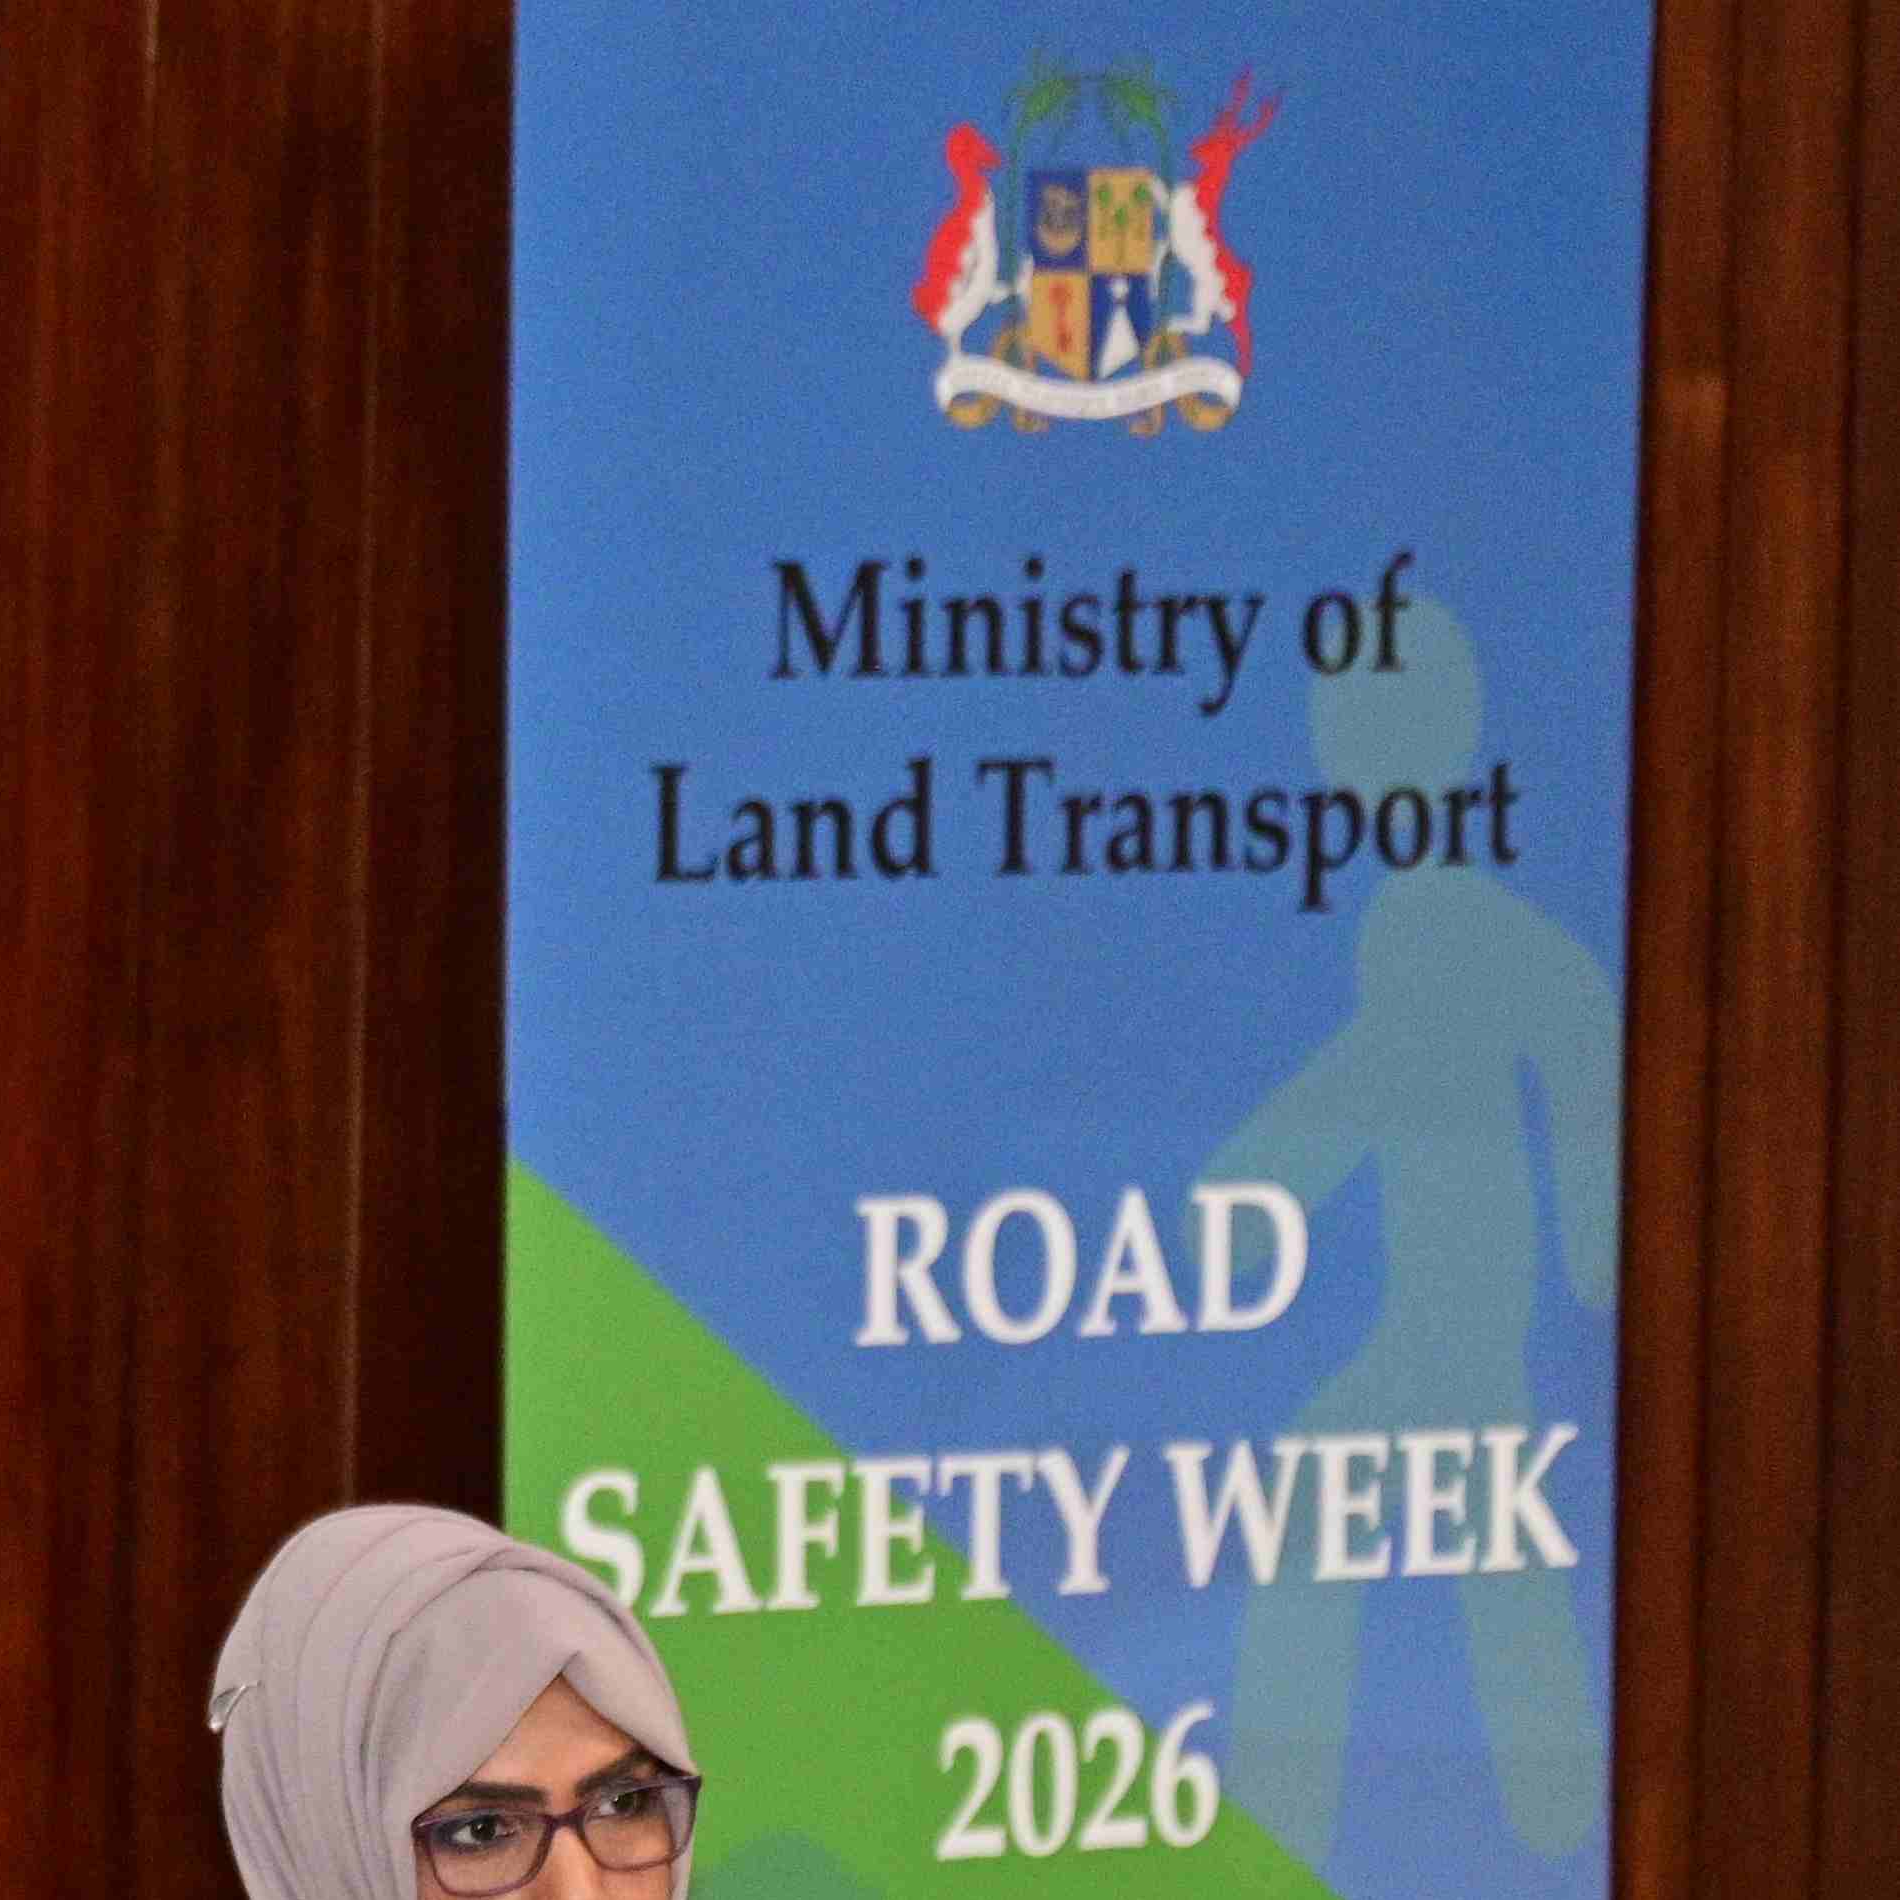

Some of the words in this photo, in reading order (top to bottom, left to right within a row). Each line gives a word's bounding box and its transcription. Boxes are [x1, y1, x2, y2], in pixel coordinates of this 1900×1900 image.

[771, 553, 1267, 716] Ministry
[1302, 553, 1415, 676] of
[650, 756, 941, 884] Land
[977, 756, 1522, 912] Transport
[854, 1180, 1310, 1348] ROAD
[559, 1446, 1131, 1620] SAFETY
[1163, 1422, 1581, 1590] WEEK
[933, 1702, 1221, 1861] 2026
